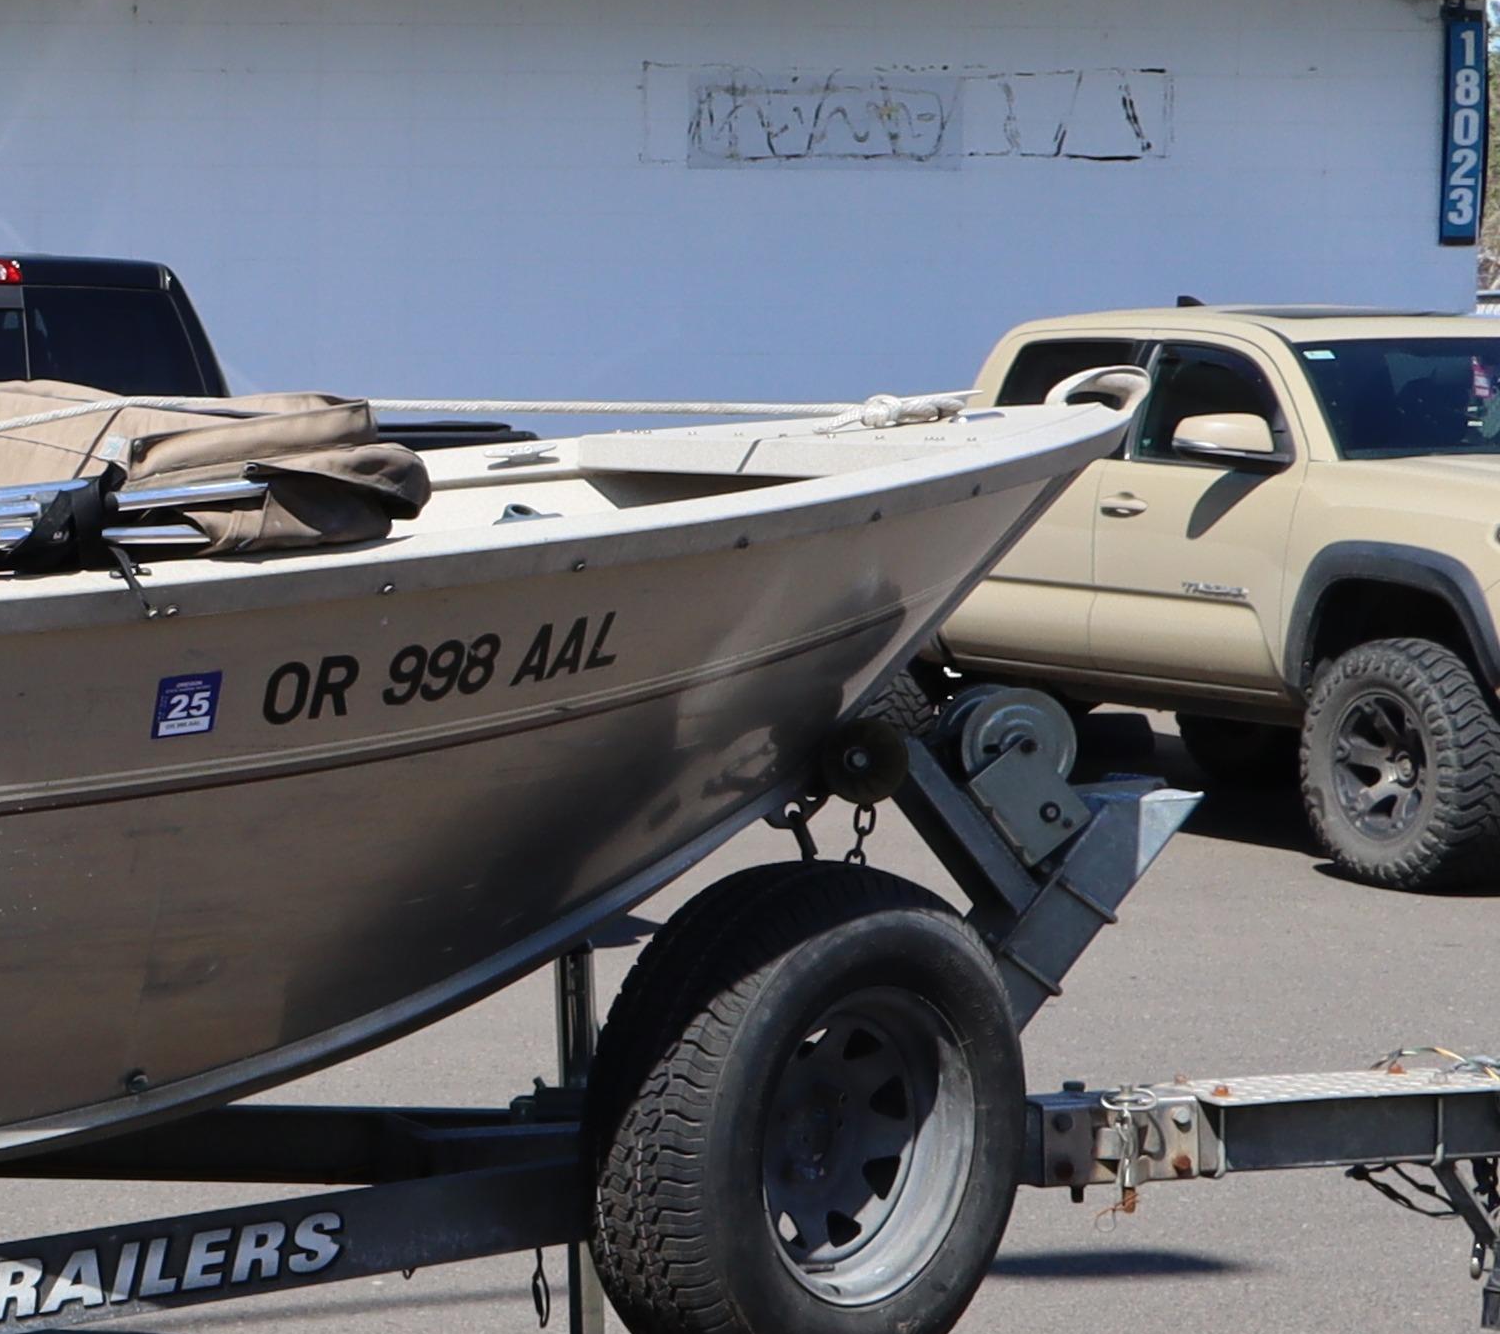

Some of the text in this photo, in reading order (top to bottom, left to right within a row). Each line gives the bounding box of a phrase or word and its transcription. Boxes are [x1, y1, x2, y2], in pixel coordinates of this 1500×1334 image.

[1447, 29, 1481, 226] 18023
[167, 691, 211, 719] 25
[262, 610, 618, 726] OR 998 AAL
